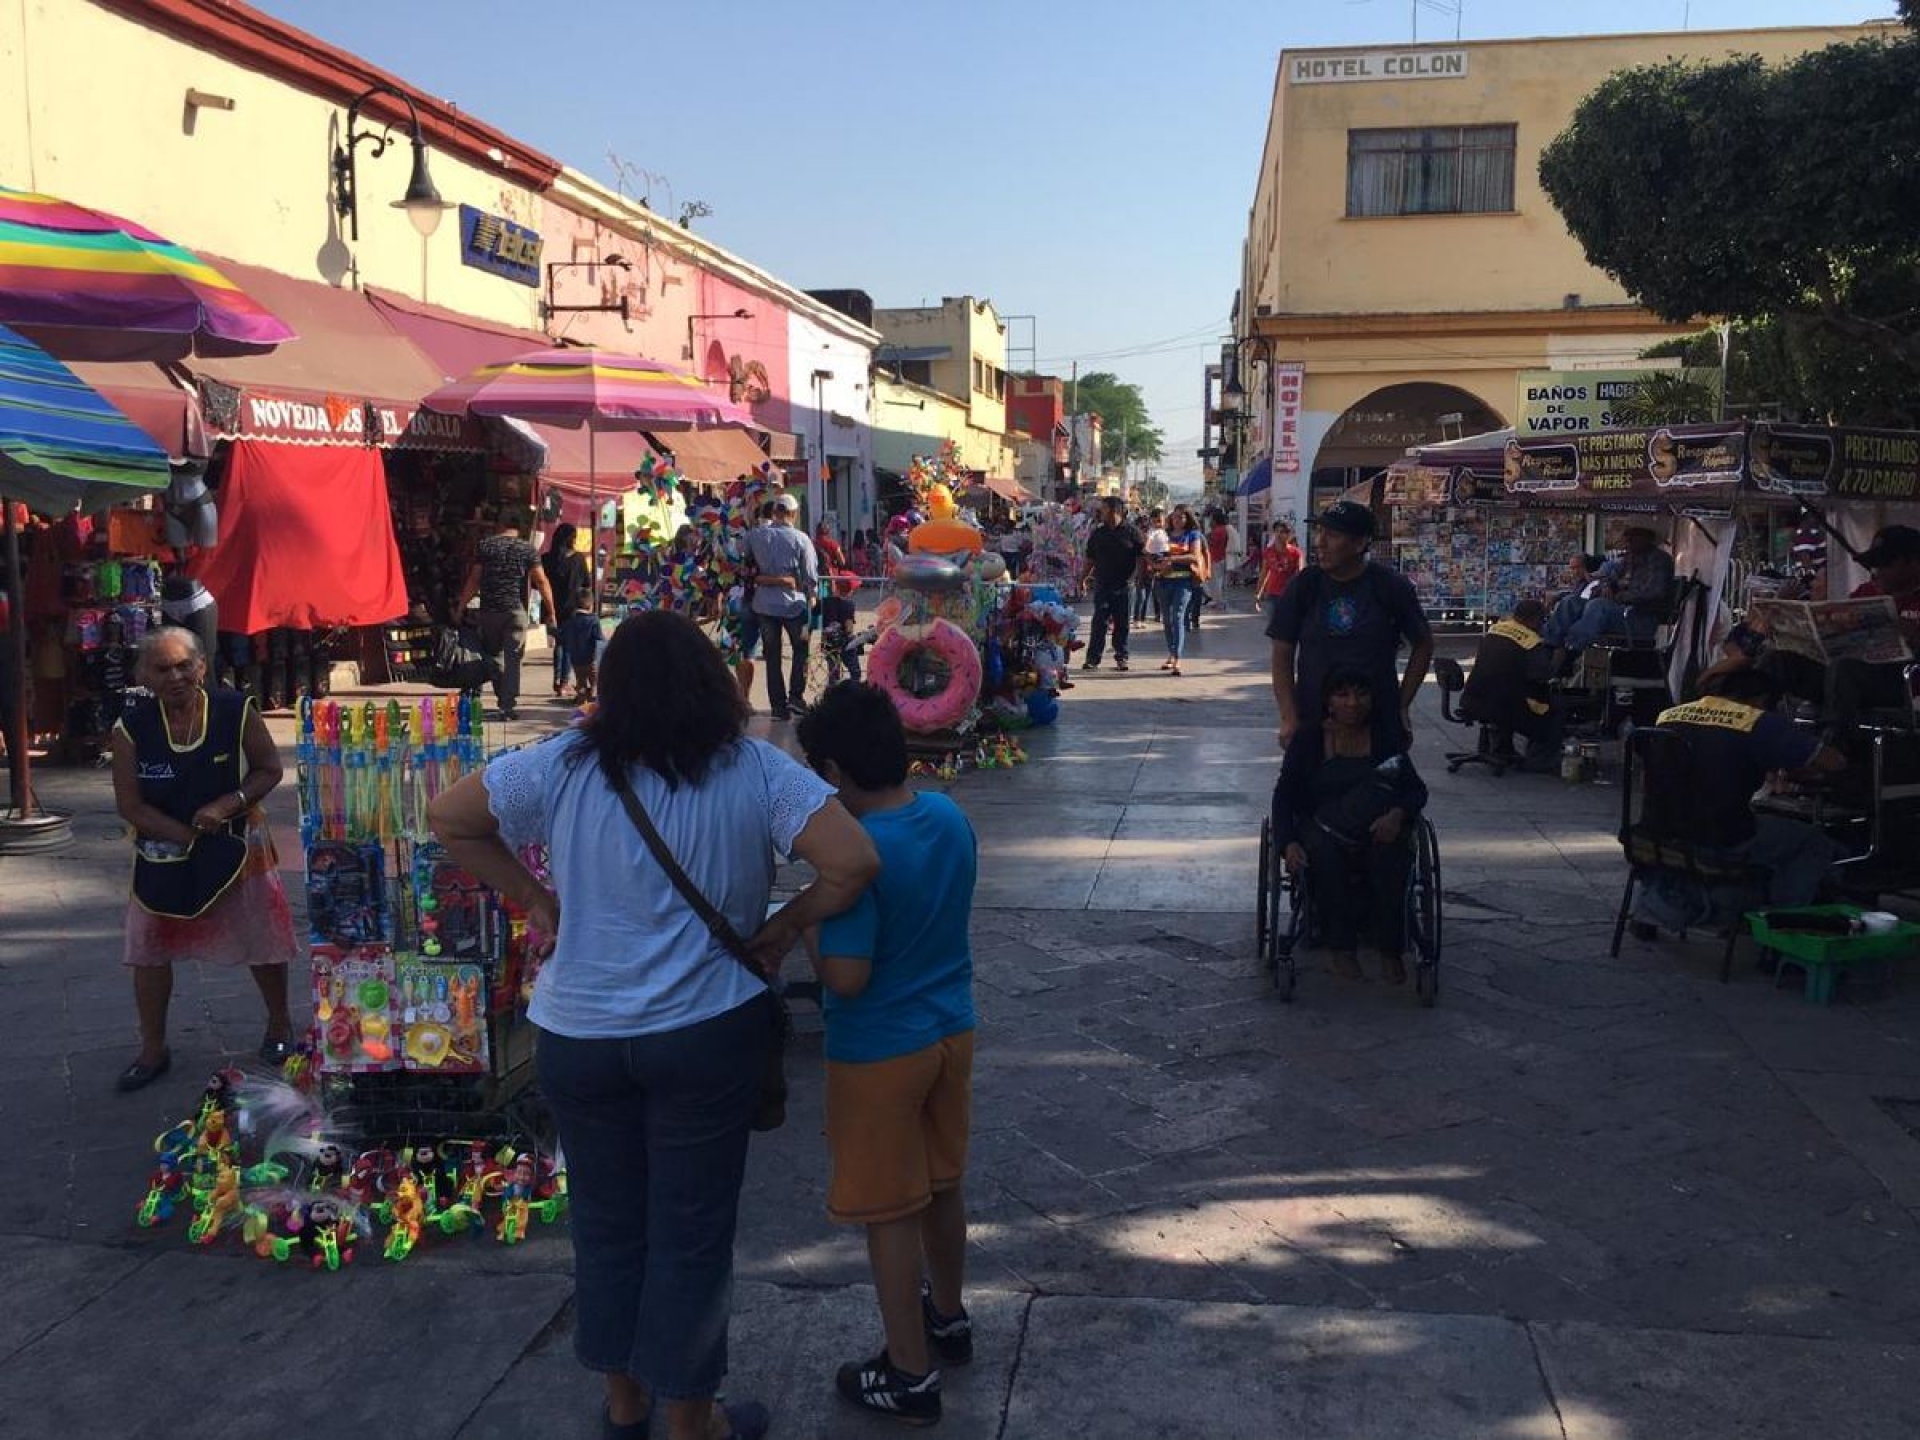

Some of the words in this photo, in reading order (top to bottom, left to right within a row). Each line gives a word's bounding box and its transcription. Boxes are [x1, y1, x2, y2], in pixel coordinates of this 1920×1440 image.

[1297, 58, 1372, 78] HOTEL
[1384, 55, 1462, 75] COLON
[1527, 384, 1588, 401] BAÑOS
[250, 398, 362, 433] NOVEDAES
[382, 409, 402, 435] EL
[1281, 375, 1299, 447] HOTEL
[1546, 405, 1565, 414] DE
[1527, 416, 1590, 432] VAPOR
[1578, 436, 1588, 452] TE
[1590, 433, 1646, 452] PRESTAMOS
